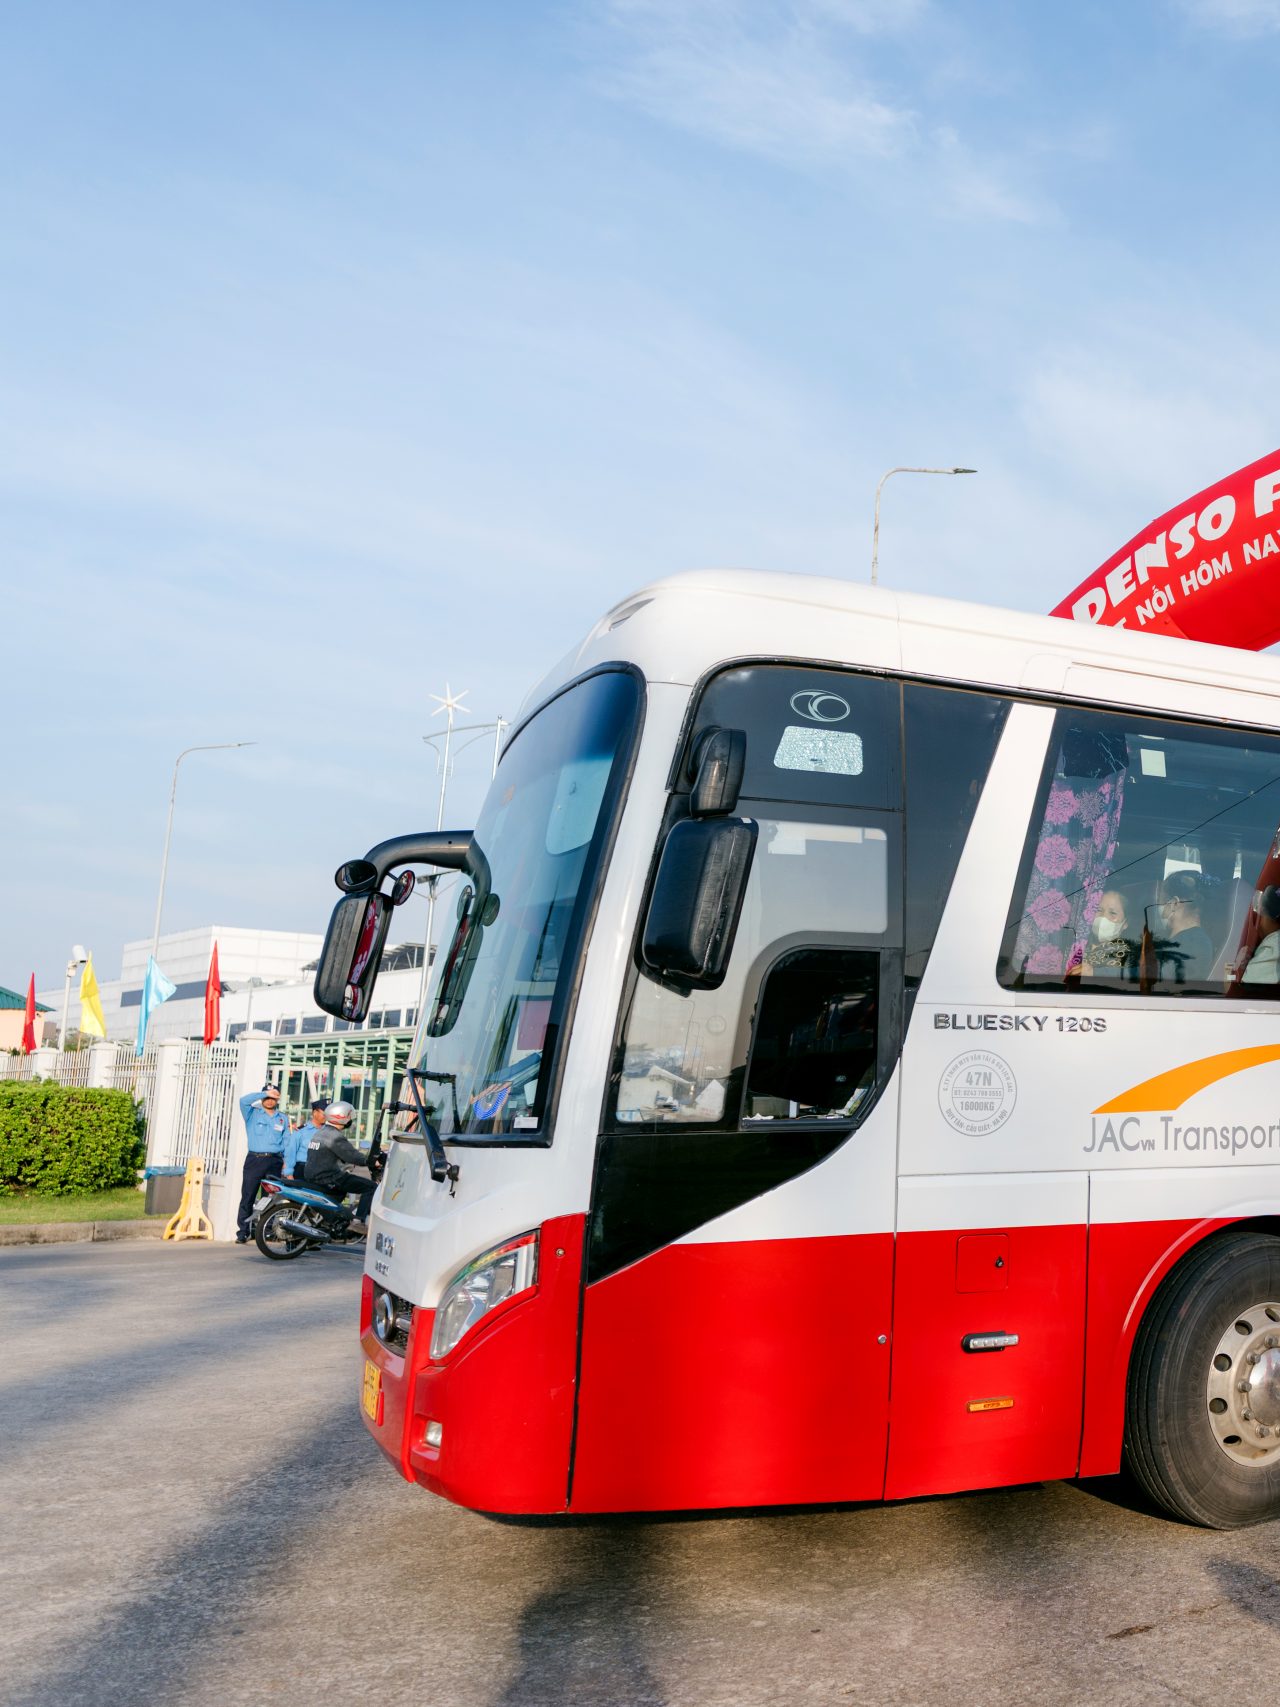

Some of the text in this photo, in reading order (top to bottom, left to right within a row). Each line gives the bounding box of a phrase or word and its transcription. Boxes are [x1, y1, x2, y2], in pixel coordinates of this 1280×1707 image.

[1072, 495, 1235, 625] DENSO
[1136, 584, 1176, 625] NỐI
[1181, 552, 1232, 595] HÔM
[934, 1013, 1107, 1033] BLUESKY 120S
[966, 1071, 993, 1087] 47N
[960, 1100, 995, 1111] 16000KG
